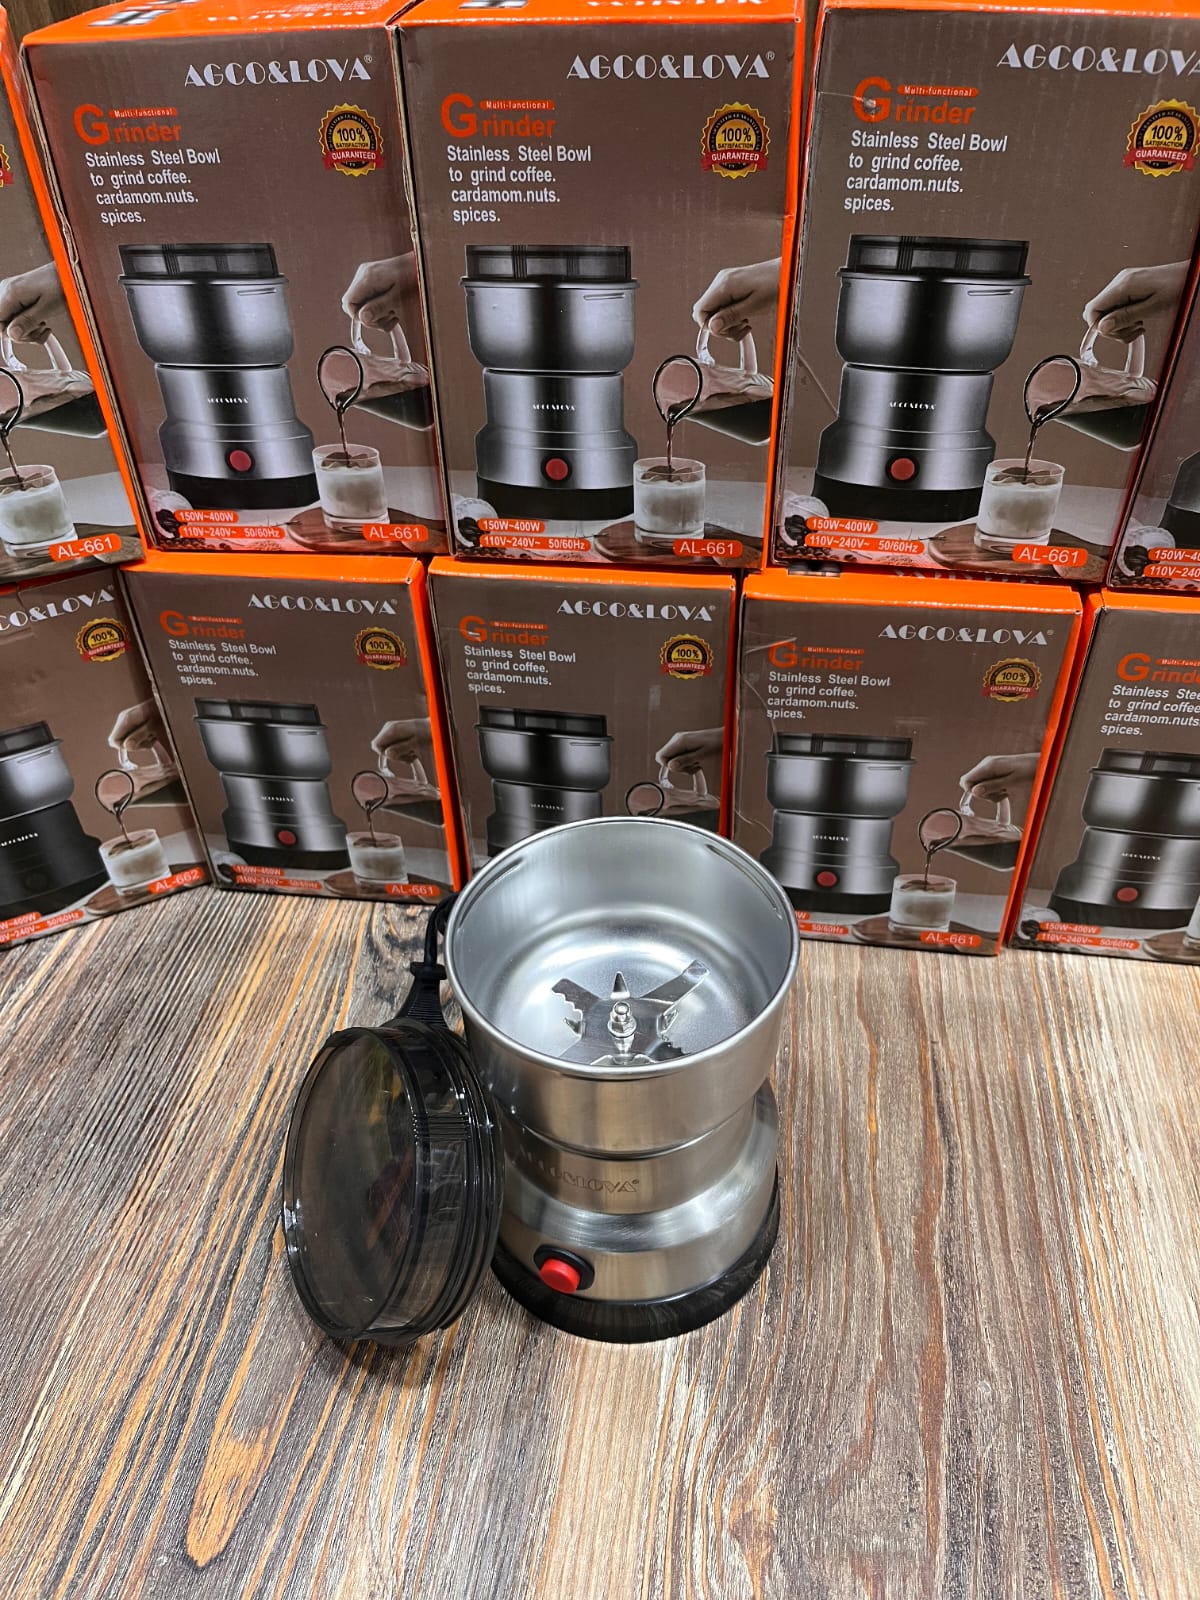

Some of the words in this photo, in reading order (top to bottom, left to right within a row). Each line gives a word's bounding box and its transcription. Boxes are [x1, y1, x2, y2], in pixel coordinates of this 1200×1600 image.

[904, 86, 972, 97] Multi-functional
[440, 93, 557, 138] Grinder
[73, 103, 182, 145] Grinder
[336, 127, 366, 142] 100%
[721, 127, 751, 142] 100%
[1151, 125, 1183, 141] 100%
[851, 130, 919, 150] Stainless
[927, 132, 965, 151] Steel
[969, 134, 1008, 153] Bowl
[85, 151, 145, 167] Stainless
[151, 149, 185, 166] Steel
[187, 148, 221, 165] Bowl
[331, 150, 377, 162] GUARANTEED
[447, 145, 510, 162] Stainless
[518, 145, 552, 161] Steel
[556, 145, 591, 161] Bowl
[711, 150, 760, 162] GUARANTEED
[1135, 150, 1187, 161] GUARANTEED
[849, 154, 863, 169] to
[871, 154, 910, 173] grind
[914, 155, 963, 172] coffee.
[90, 171, 104, 186] to
[110, 170, 144, 189] grind
[147, 170, 191, 185] coffee.
[449, 167, 462, 182] to
[471, 166, 506, 185] grind
[510, 166, 556, 182] coffee.
[846, 174, 963, 193] cardamom.nuts.
[96, 189, 199, 205] cardamom.nuts.
[451, 187, 560, 202] cardamom.nuts.
[844, 195, 895, 214] spices.
[100, 208, 146, 227] spices.
[453, 207, 501, 225] spices.
[369, 527, 420, 540] AL-661
[57, 536, 113, 559] AL-661
[679, 542, 734, 555] AL-661
[878, 540, 919, 553] 50/60Hz
[1020, 549, 1080, 564] AL-661
[91, 630, 115, 643] 100%
[168, 639, 216, 652] Stainless
[221, 642, 248, 654] Steel
[250, 643, 277, 655] Bowl
[369, 640, 392, 651] 100%
[172, 651, 183, 662] to
[189, 652, 215, 665] grind
[218, 654, 253, 665] coffee.
[464, 645, 513, 659] Stainless
[519, 649, 546, 661] Steel
[549, 650, 576, 663] Bowl
[675, 648, 699, 659] 100%
[465, 658, 476, 668] to
[482, 659, 510, 673] grind
[512, 661, 549, 673] coffee.
[181, 674, 217, 686] spices.
[769, 671, 821, 684] Stainless
[828, 673, 858, 686] Steel
[860, 674, 890, 687] Bowl
[1001, 670, 1026, 682] 100%
[468, 683, 506, 695] spices.
[768, 684, 779, 694] to
[786, 685, 815, 697] grind
[819, 685, 857, 698] coffee.
[1112, 684, 1169, 698] Stainless
[1108, 698, 1120, 708] to
[1127, 699, 1161, 712] grind
[767, 708, 806, 720] spices.
[1100, 724, 1143, 736] spices.
[155, 870, 200, 891] AL-662
[391, 885, 434, 895] AL-661
[925, 933, 974, 945] AL-661
